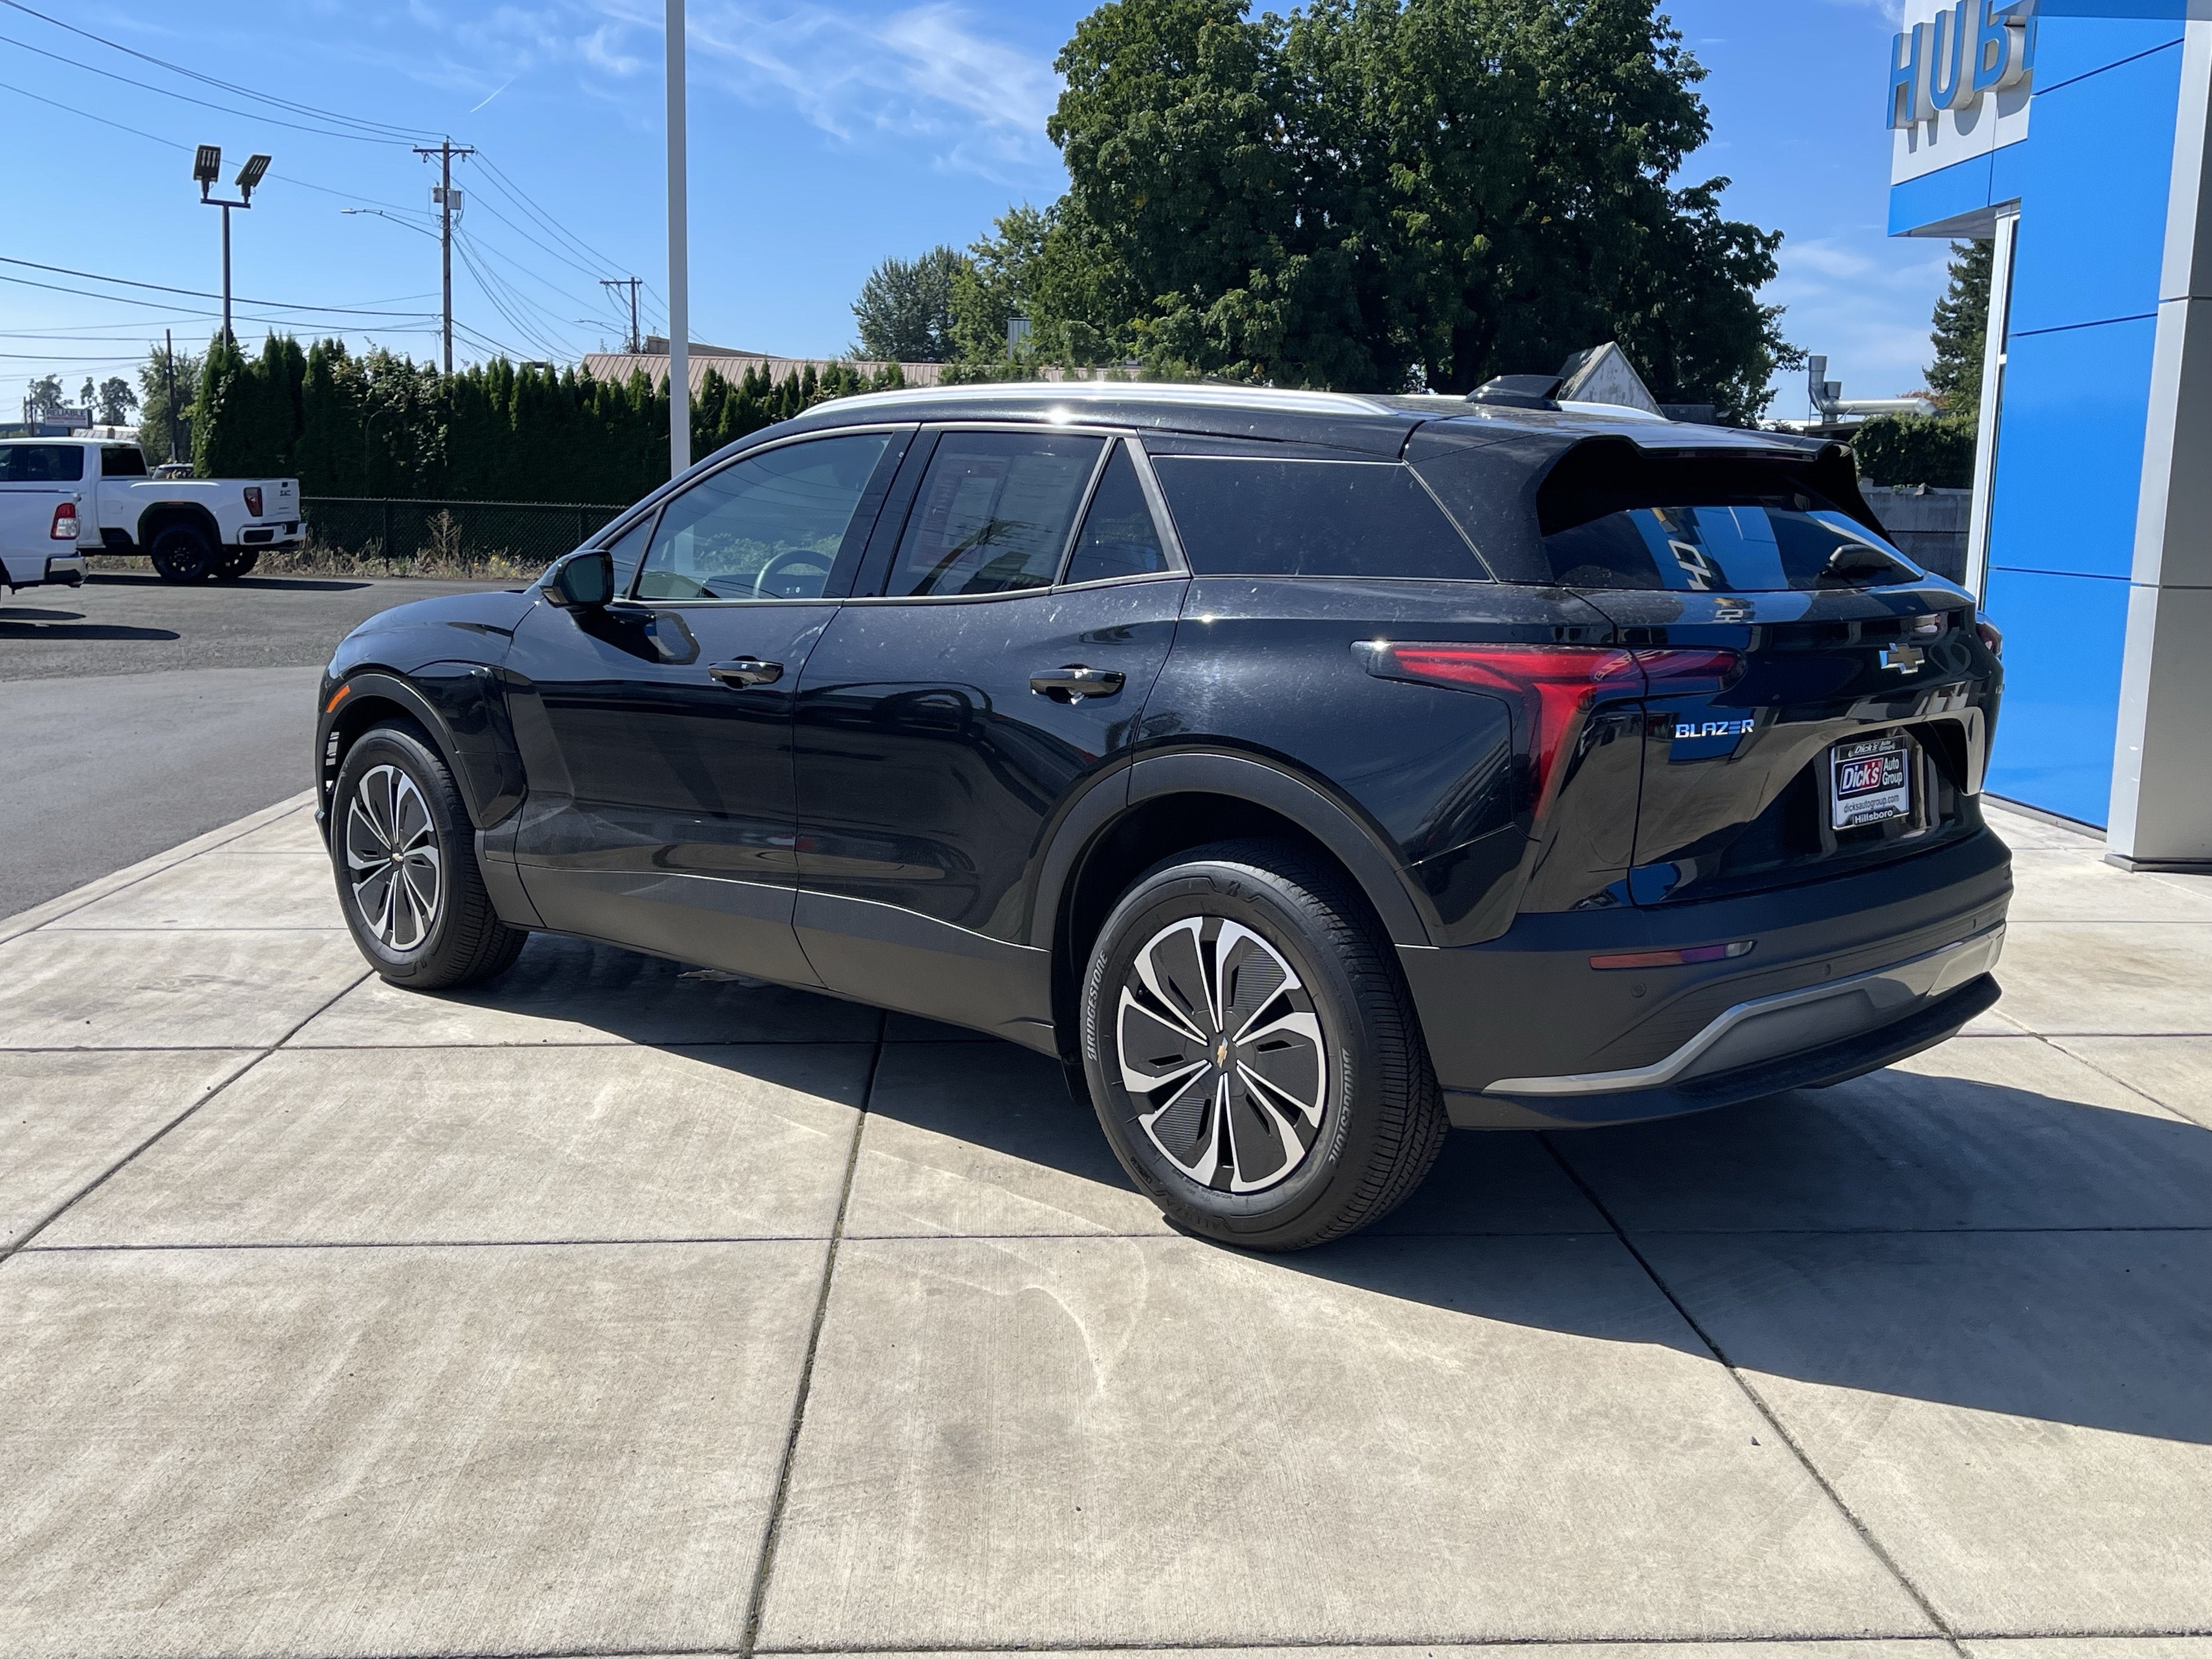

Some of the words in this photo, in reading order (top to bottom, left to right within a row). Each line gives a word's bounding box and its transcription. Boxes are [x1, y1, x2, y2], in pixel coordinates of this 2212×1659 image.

[1675, 719, 1754, 738] BLAZER
[1883, 757, 1899, 771] Auto
[1842, 762, 1880, 789] Dick's
[1882, 771, 1903, 786] Group
[1844, 794, 1899, 813] dicksautogroup.com
[1855, 810, 1893, 824] Hillsboro
[1087, 950, 1108, 1062] BRIDGESTONE
